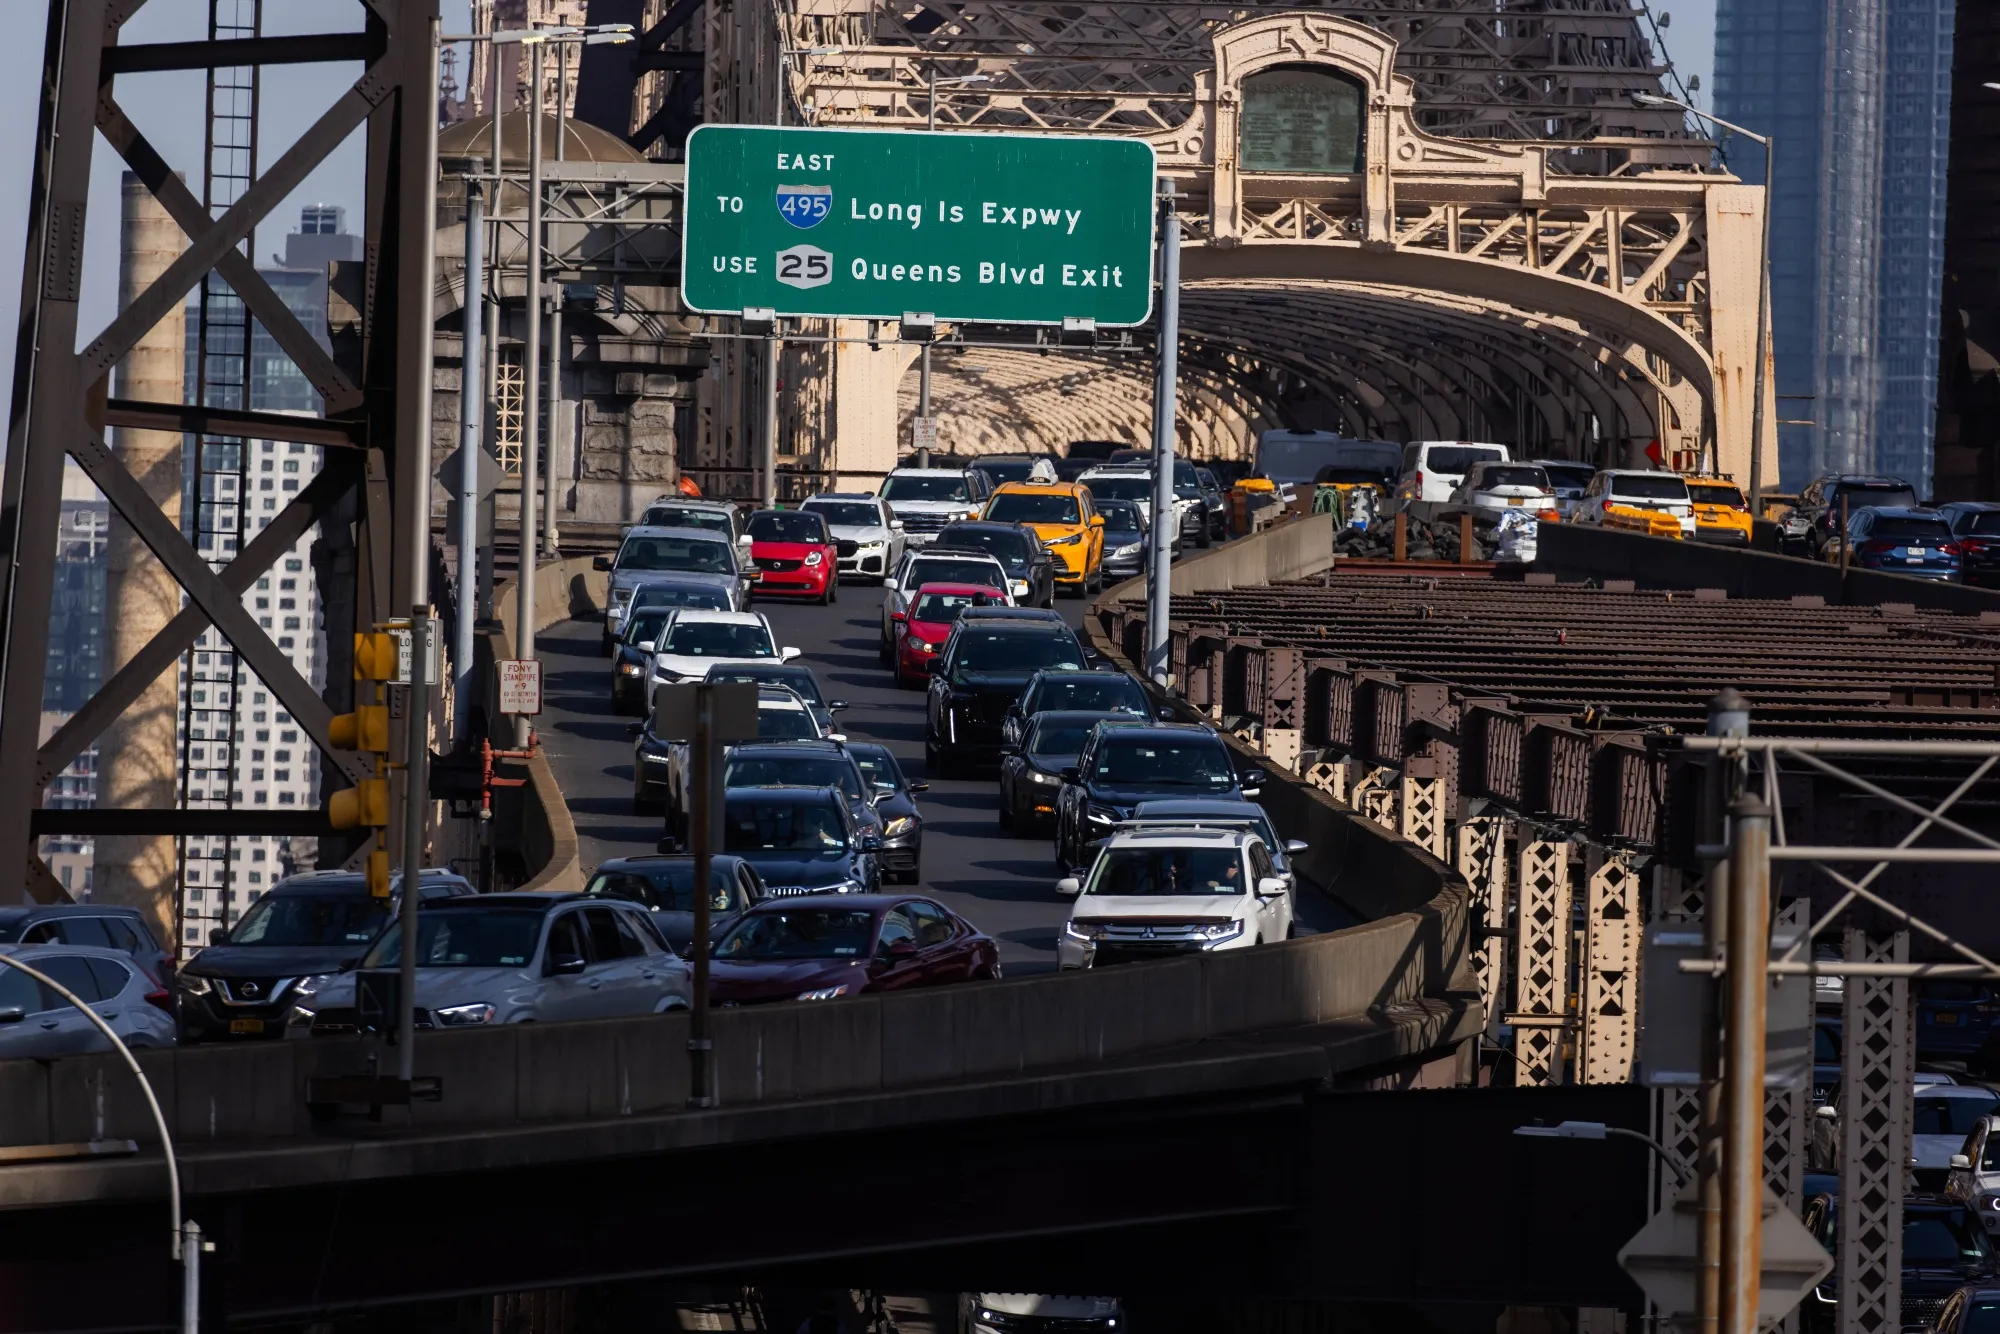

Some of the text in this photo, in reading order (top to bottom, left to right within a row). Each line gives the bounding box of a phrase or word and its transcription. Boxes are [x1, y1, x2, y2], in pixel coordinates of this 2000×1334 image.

[777, 153, 835, 171] EAST
[717, 196, 1082, 235] TO 495 Long Is Expwy
[713, 254, 1123, 288] USE 25 Queens Blvd Exit
[503, 673, 537, 681] STANDPIPE
[507, 664, 532, 672] FDNY
